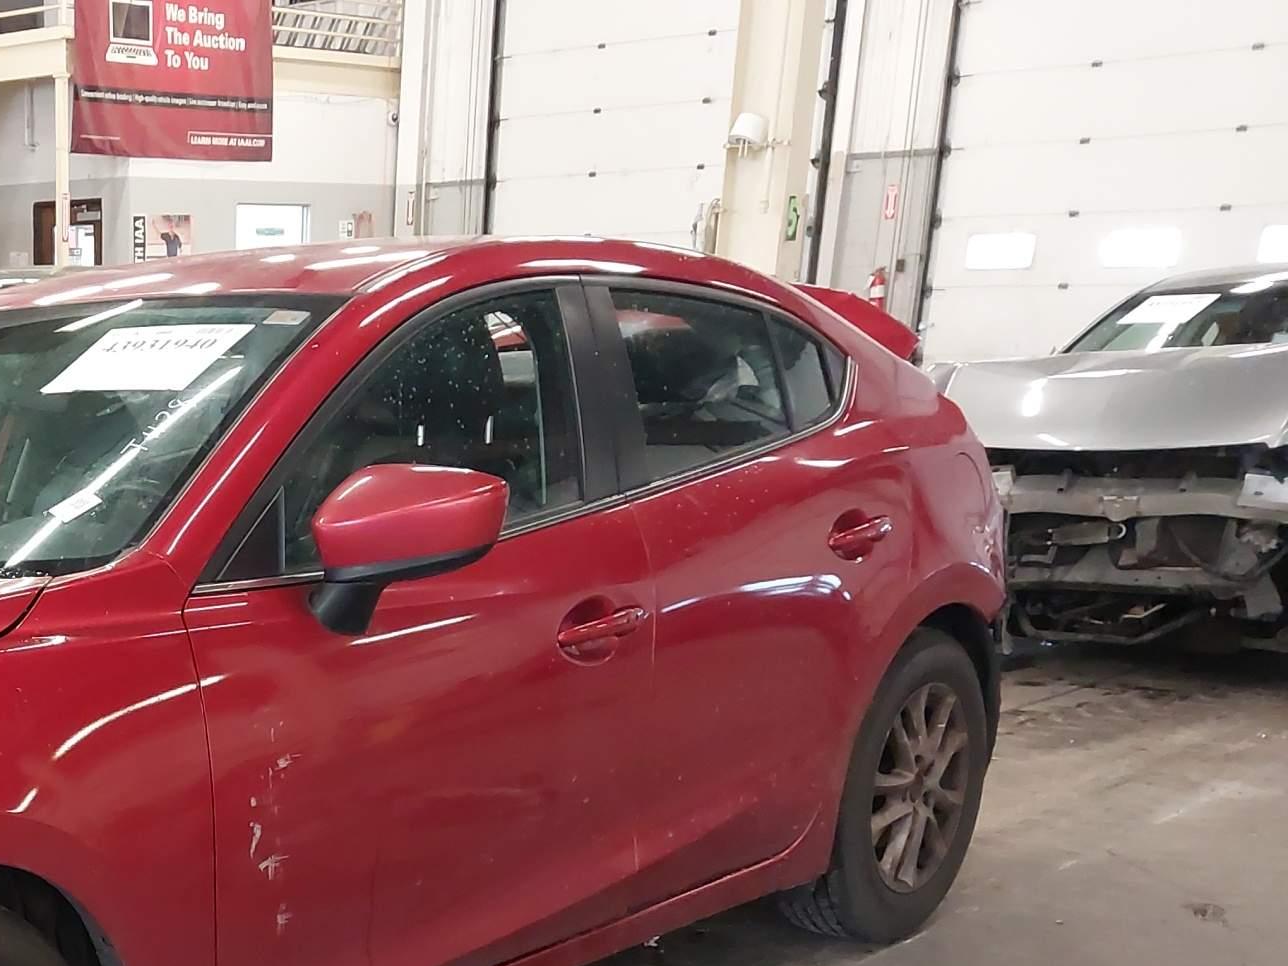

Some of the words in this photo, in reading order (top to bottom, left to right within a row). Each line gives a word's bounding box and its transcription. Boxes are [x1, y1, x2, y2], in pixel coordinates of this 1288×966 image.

[165, 3, 186, 22] We
[188, 5, 225, 30] Bring
[165, 26, 190, 46] The
[193, 29, 246, 51] Auction
[164, 49, 181, 68] To
[184, 51, 209, 70] You
[135, 219, 145, 244] IAA
